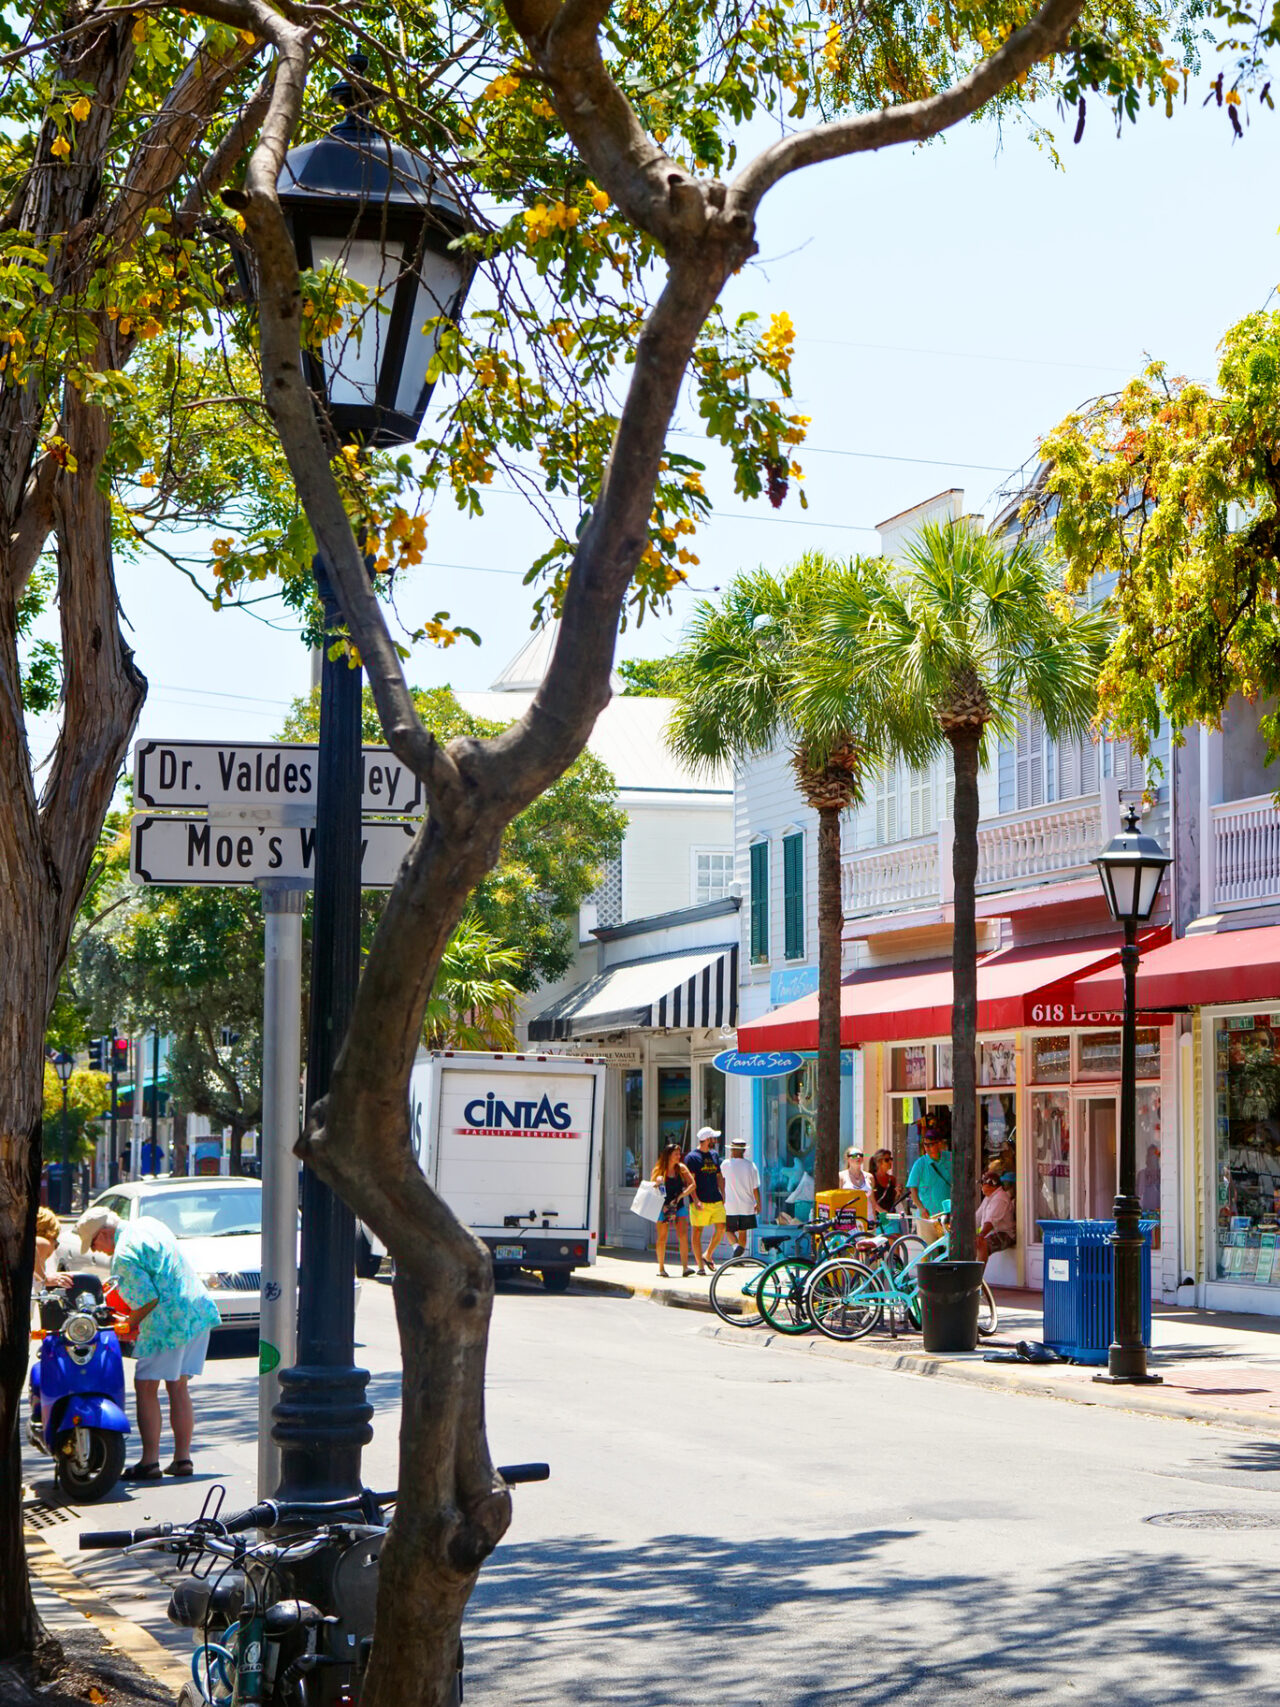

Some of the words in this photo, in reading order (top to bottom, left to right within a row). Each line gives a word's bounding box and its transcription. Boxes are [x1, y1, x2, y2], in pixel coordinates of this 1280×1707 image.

[160, 749, 201, 791] Dr.
[218, 751, 312, 793] Valdes
[187, 824, 283, 868] Moe's
[1031, 1003, 1065, 1022] 618
[724, 1052, 766, 1070] Fanta
[767, 1052, 793, 1068] Sea
